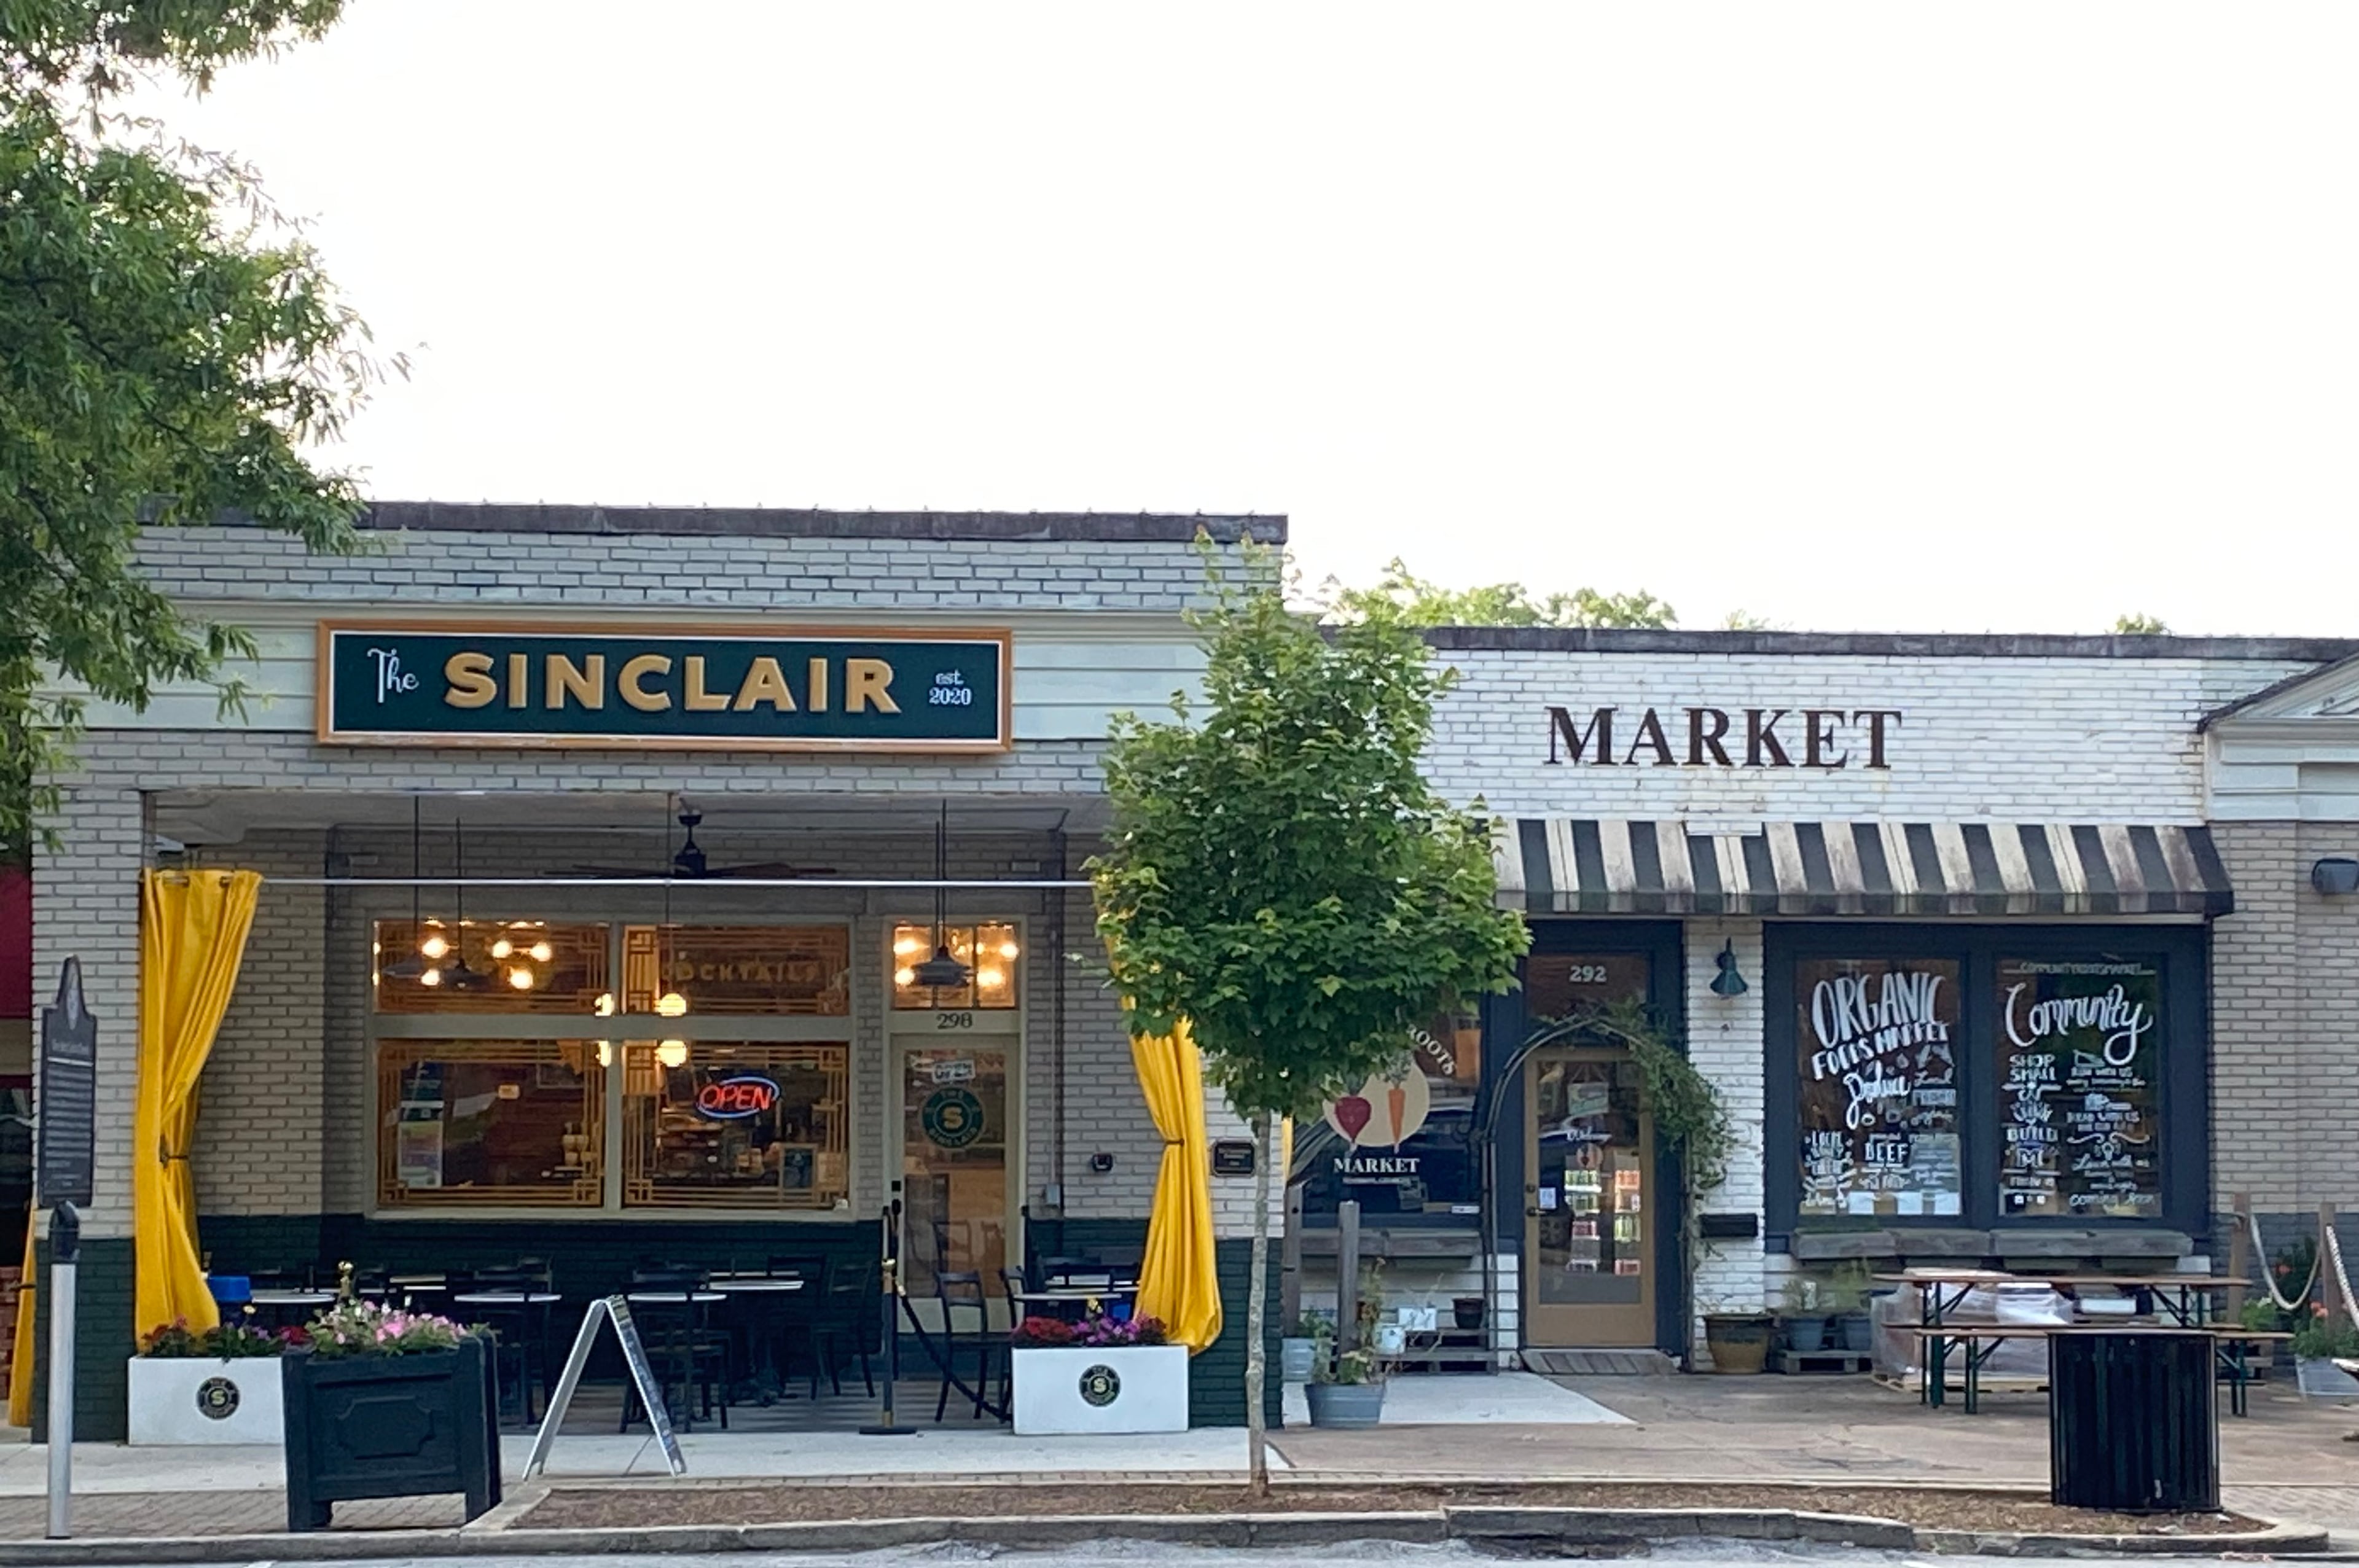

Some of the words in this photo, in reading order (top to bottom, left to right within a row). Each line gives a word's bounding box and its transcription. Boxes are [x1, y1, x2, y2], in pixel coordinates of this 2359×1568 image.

[367, 648, 419, 703] The
[443, 651, 902, 714] SINCLAIR
[928, 687, 972, 705] 2020
[1542, 706, 1902, 770] MARKET
[1568, 965, 1607, 982] 292
[1812, 972, 1947, 1049] ORGANIC
[936, 1012, 972, 1030] 298
[2005, 983, 2153, 1066] Community
[1812, 1037, 1875, 1081] FOODS
[1874, 1021, 1949, 1055] MARKET
[2009, 1054, 2056, 1067] SHOP
[2009, 1067, 2057, 1082] SMALL
[698, 1083, 773, 1110] OPEN
[942, 1106, 963, 1129] S
[2006, 1127, 2058, 1142] BUILD
[1864, 1142, 1909, 1163] BEEF
[1333, 1157, 1420, 1174] MARKET
[211, 1389, 225, 1406] S
